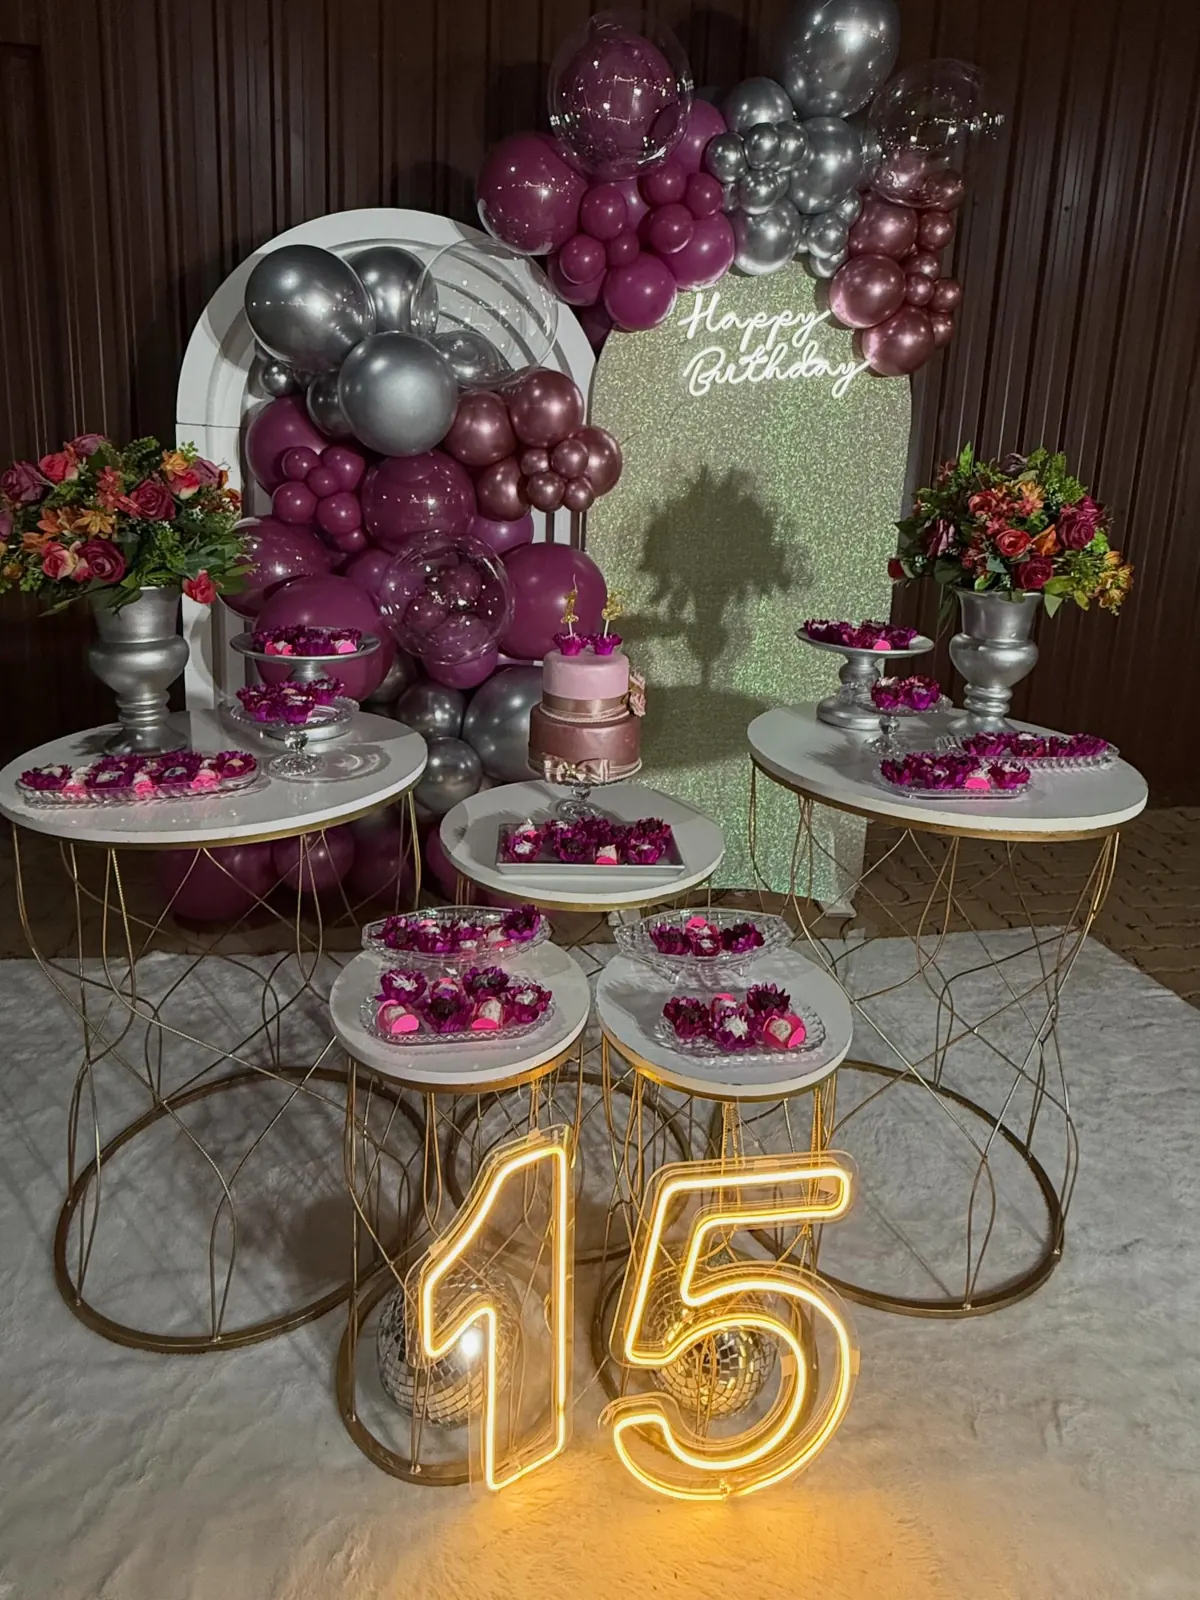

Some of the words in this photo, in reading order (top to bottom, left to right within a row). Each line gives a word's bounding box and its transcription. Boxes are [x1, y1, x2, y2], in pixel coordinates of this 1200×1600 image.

[678, 291, 833, 352] Happy
[682, 339, 873, 398] Birthday
[422, 1144, 852, 1501] 15
